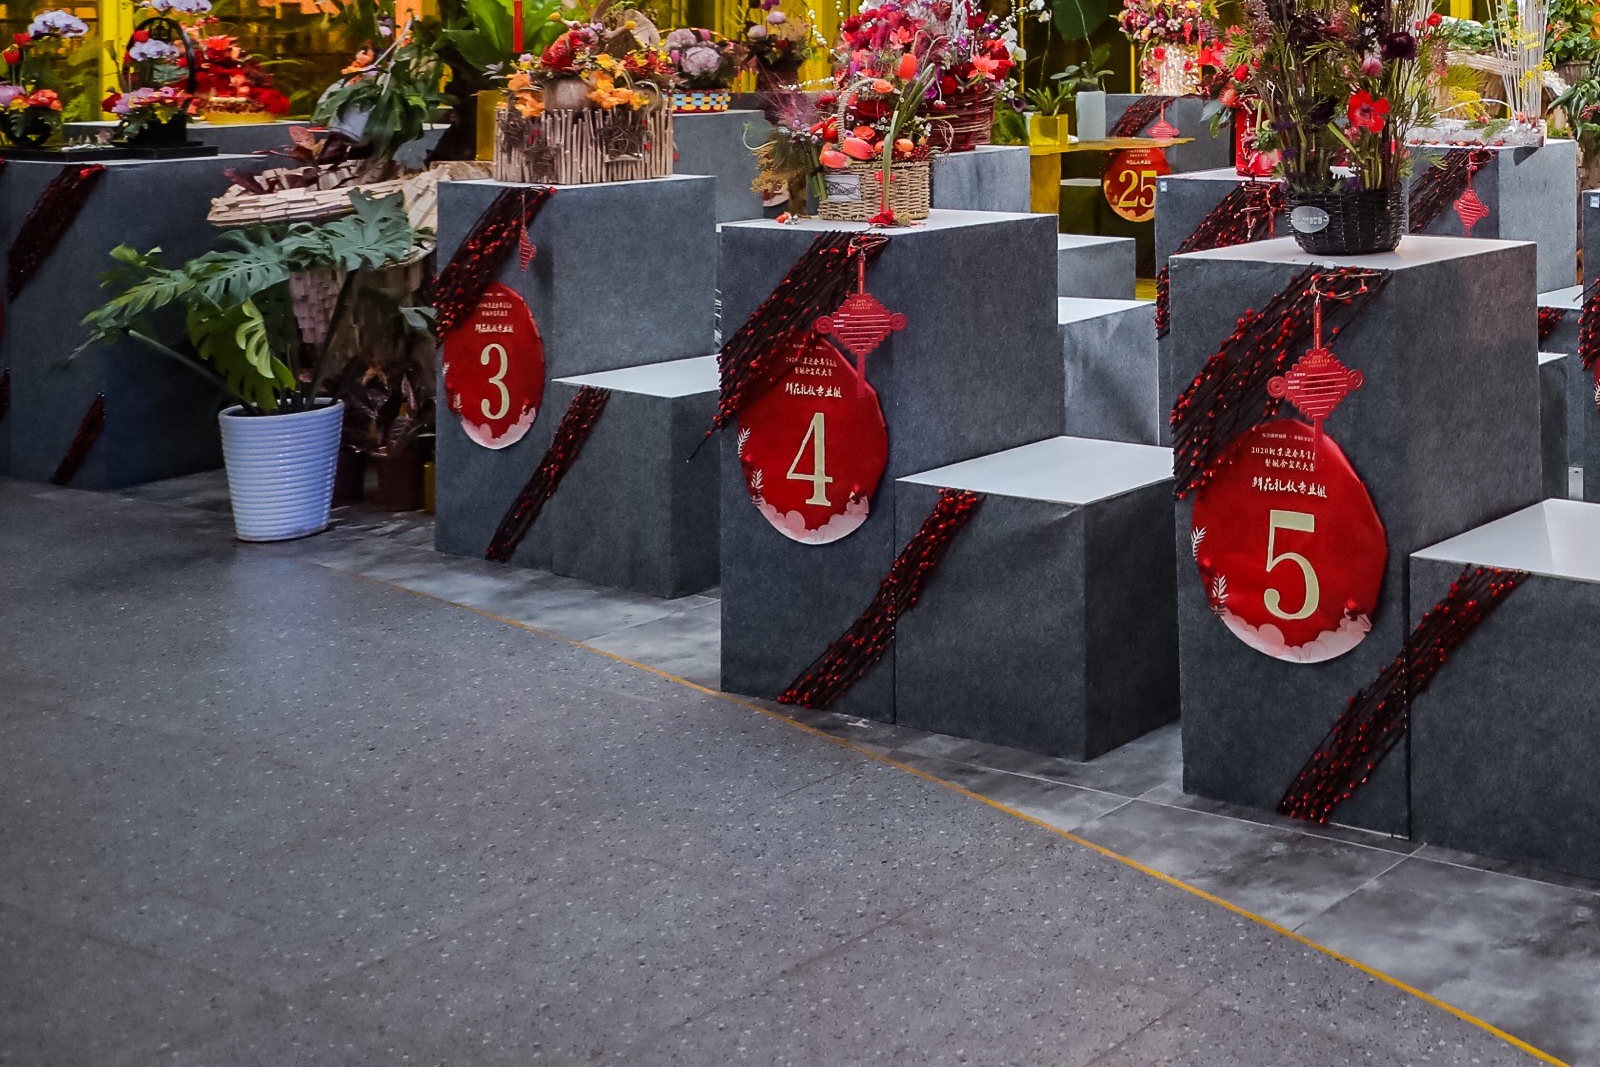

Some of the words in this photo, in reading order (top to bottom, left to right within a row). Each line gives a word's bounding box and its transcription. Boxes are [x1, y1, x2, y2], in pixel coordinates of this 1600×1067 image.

[1117, 169, 1157, 208] 25
[480, 343, 510, 420] 3
[784, 382, 843, 399] 鲜花礼仪专业组
[786, 412, 834, 507] 4
[1251, 476, 1328, 499] 鲜花礼仪专业组
[1263, 509, 1320, 620] 5
